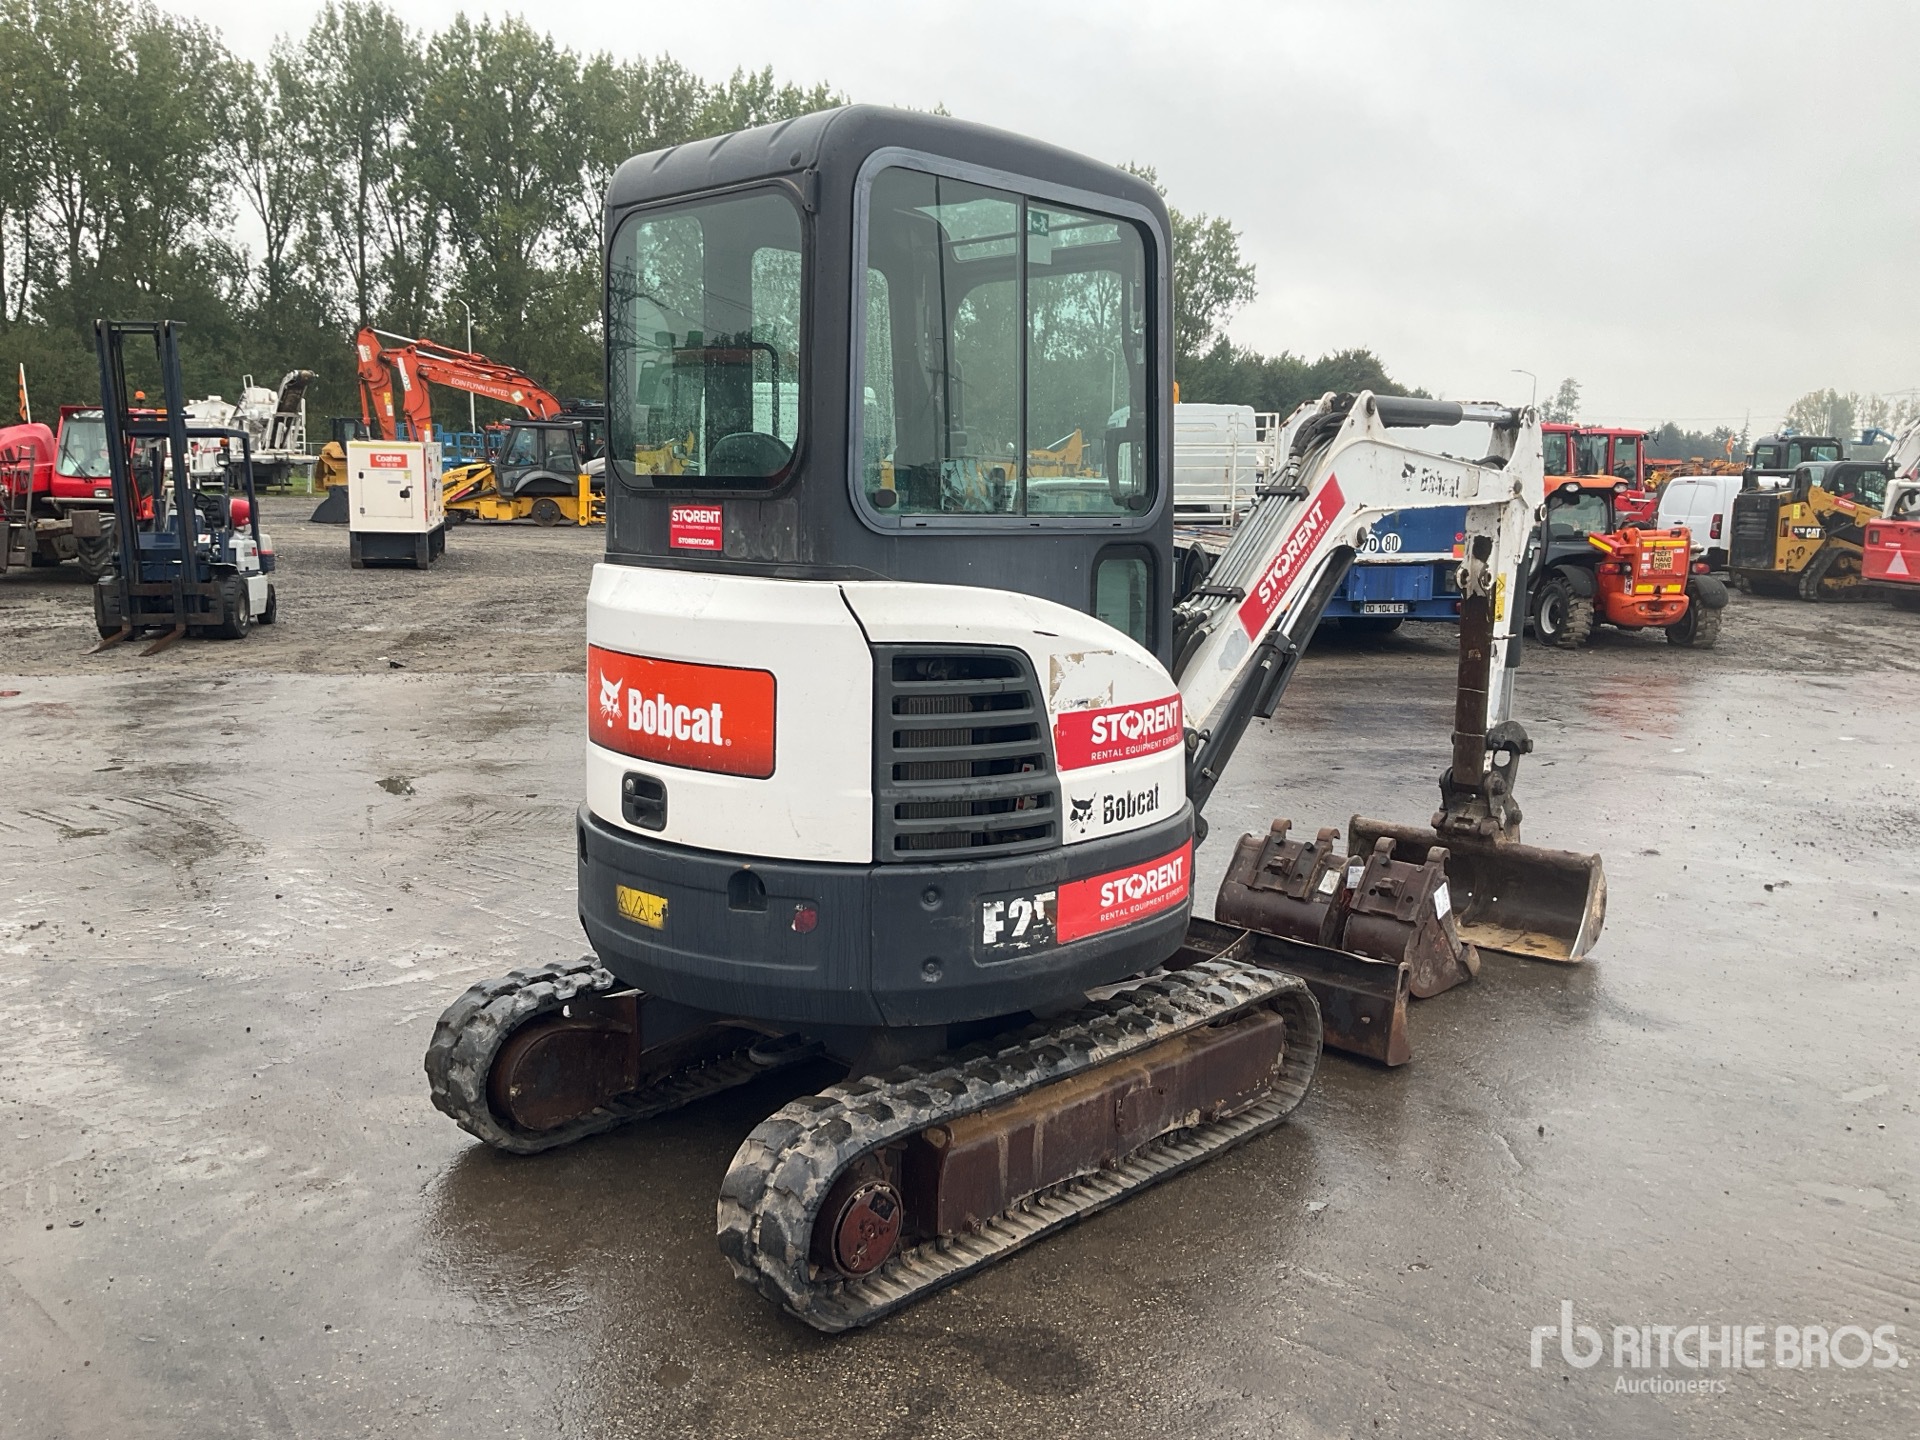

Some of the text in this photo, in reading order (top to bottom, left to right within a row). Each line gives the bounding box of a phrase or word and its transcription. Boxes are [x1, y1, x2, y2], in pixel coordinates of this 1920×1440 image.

[451, 378, 510, 397] EOIN FLYNN LIMITED
[672, 509, 721, 523] STORENT
[1806, 528, 1821, 538] CAT
[678, 537, 715, 546] STORENT.COM
[1258, 500, 1325, 605] STORENT
[1385, 535, 1399, 551] 80
[1266, 519, 1330, 614] RENTAL EQUIPMENT EXPERTS
[628, 687, 723, 746] Bobcat
[1091, 700, 1179, 745] STORENT
[1091, 733, 1179, 761] RENTAL EQUIPMENT EXPERTS
[1103, 782, 1159, 825] Bobcat
[1100, 856, 1184, 908] STORENT
[1100, 884, 1184, 922] RENTAL EQUIPMENT EXPERTS
